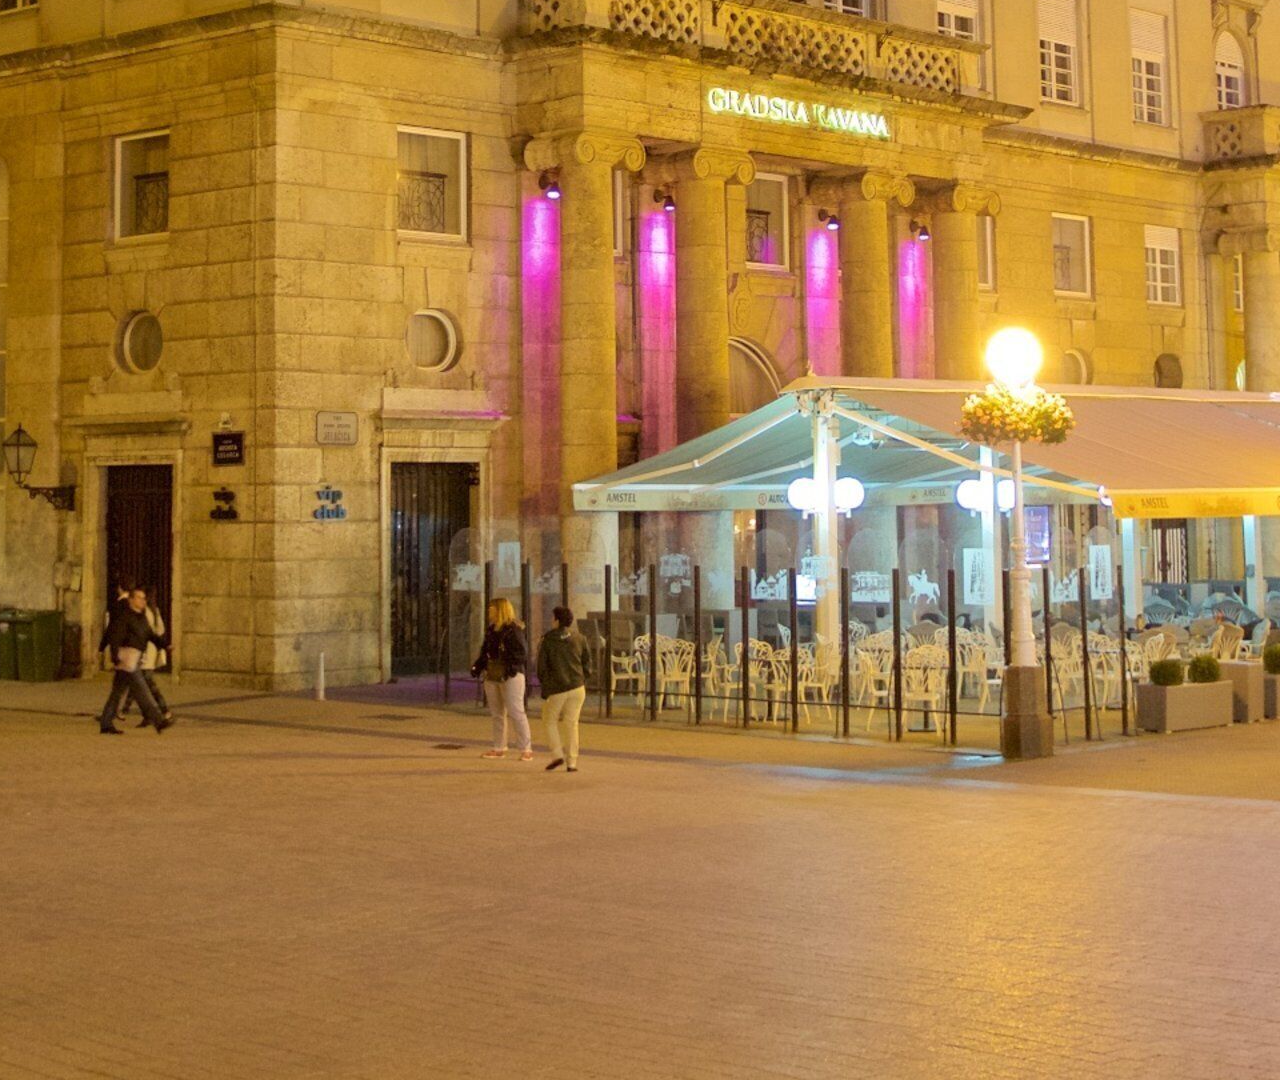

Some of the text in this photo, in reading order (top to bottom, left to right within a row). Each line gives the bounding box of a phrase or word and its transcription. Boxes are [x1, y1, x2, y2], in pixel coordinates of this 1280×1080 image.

[708, 87, 891, 138] GRADSKA KAVANA
[315, 485, 343, 504] vip
[606, 493, 637, 503] AMSTEL
[1141, 497, 1170, 509] AMSTEL
[312, 504, 347, 520] club
